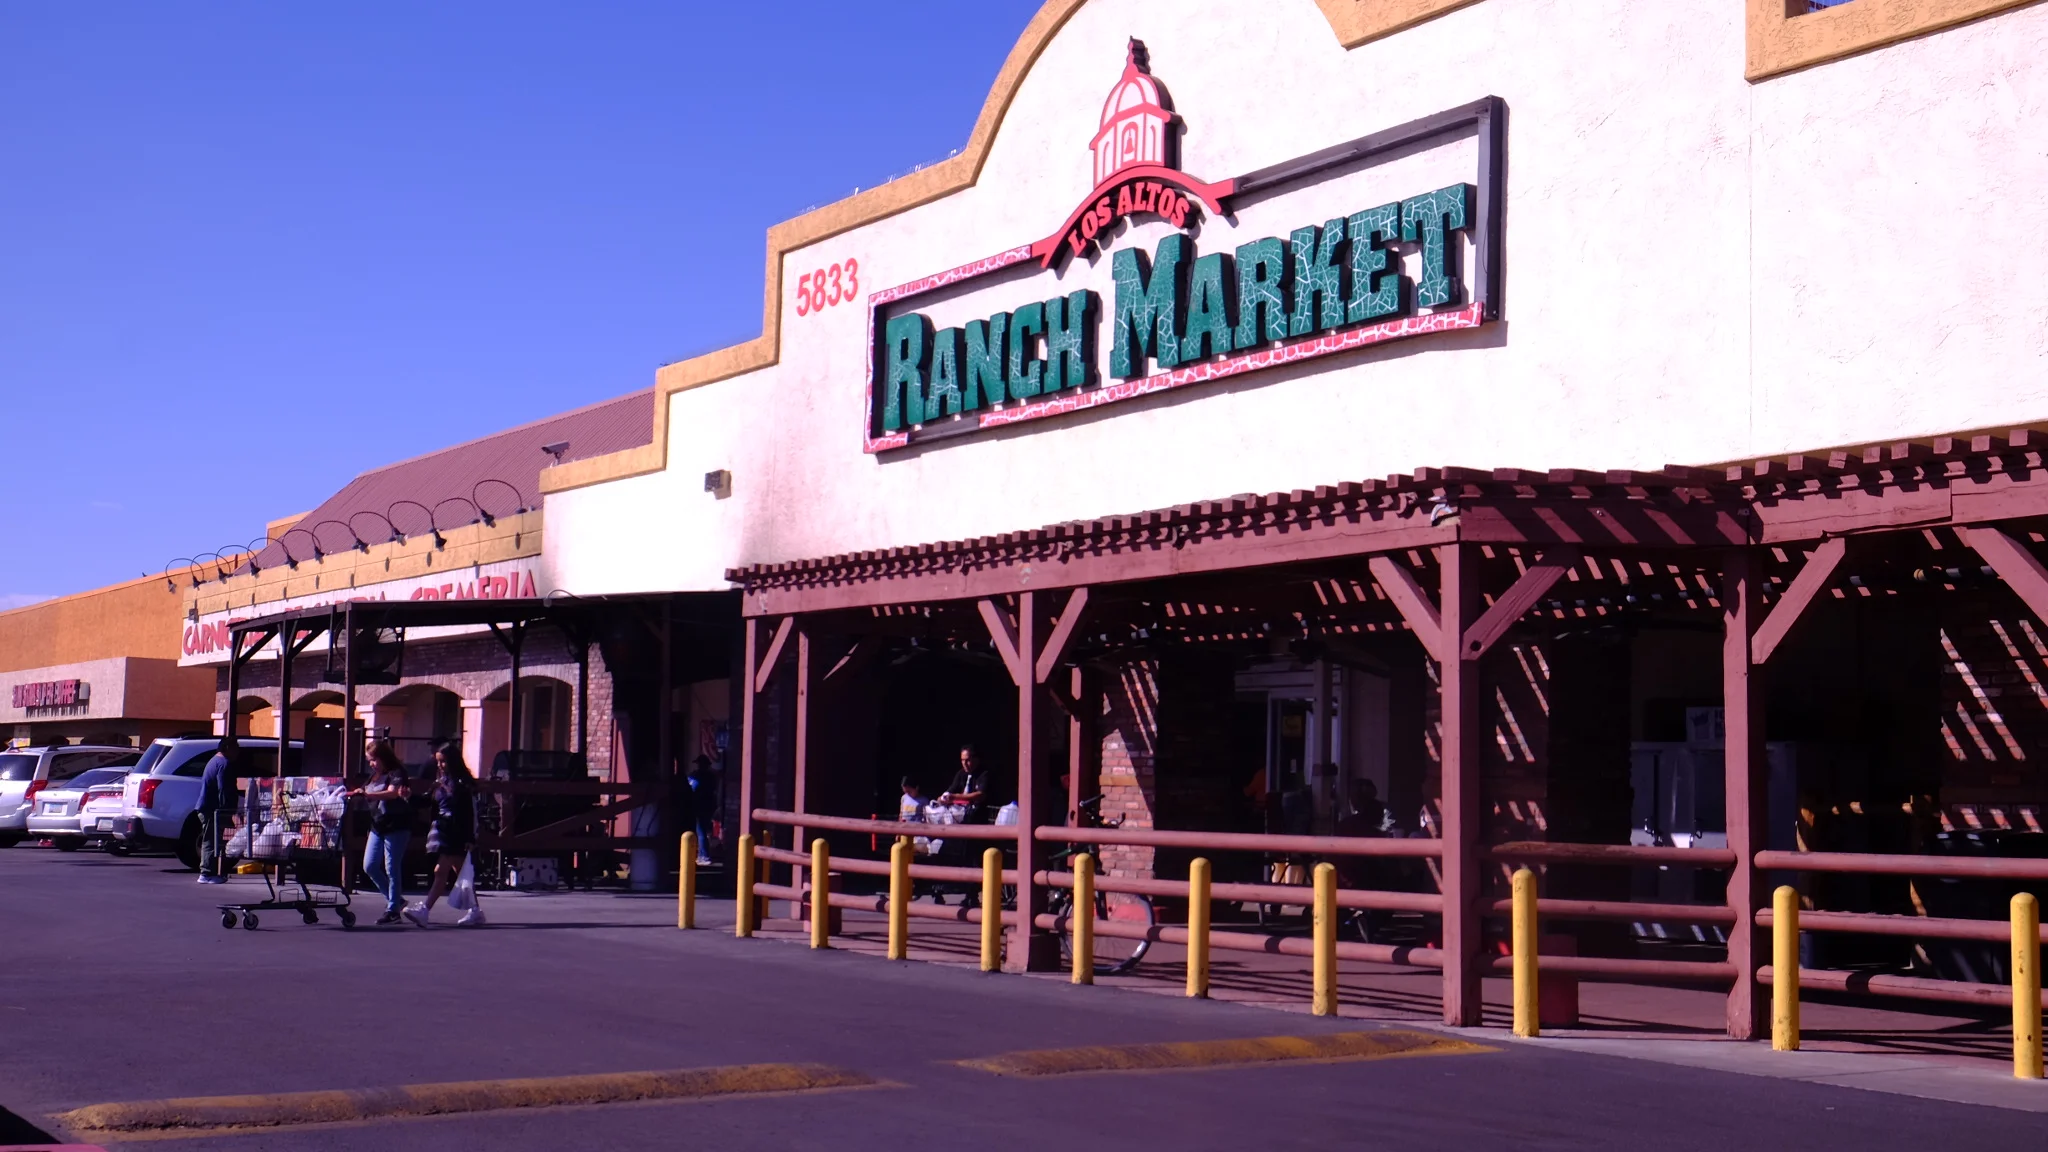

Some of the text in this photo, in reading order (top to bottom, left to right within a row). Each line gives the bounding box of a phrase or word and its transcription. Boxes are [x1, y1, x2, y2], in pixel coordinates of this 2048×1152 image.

[1068, 182, 1190, 258] LOS ALTOS
[796, 257, 859, 317] 5833
[883, 182, 1468, 431] RANCH MARKET
